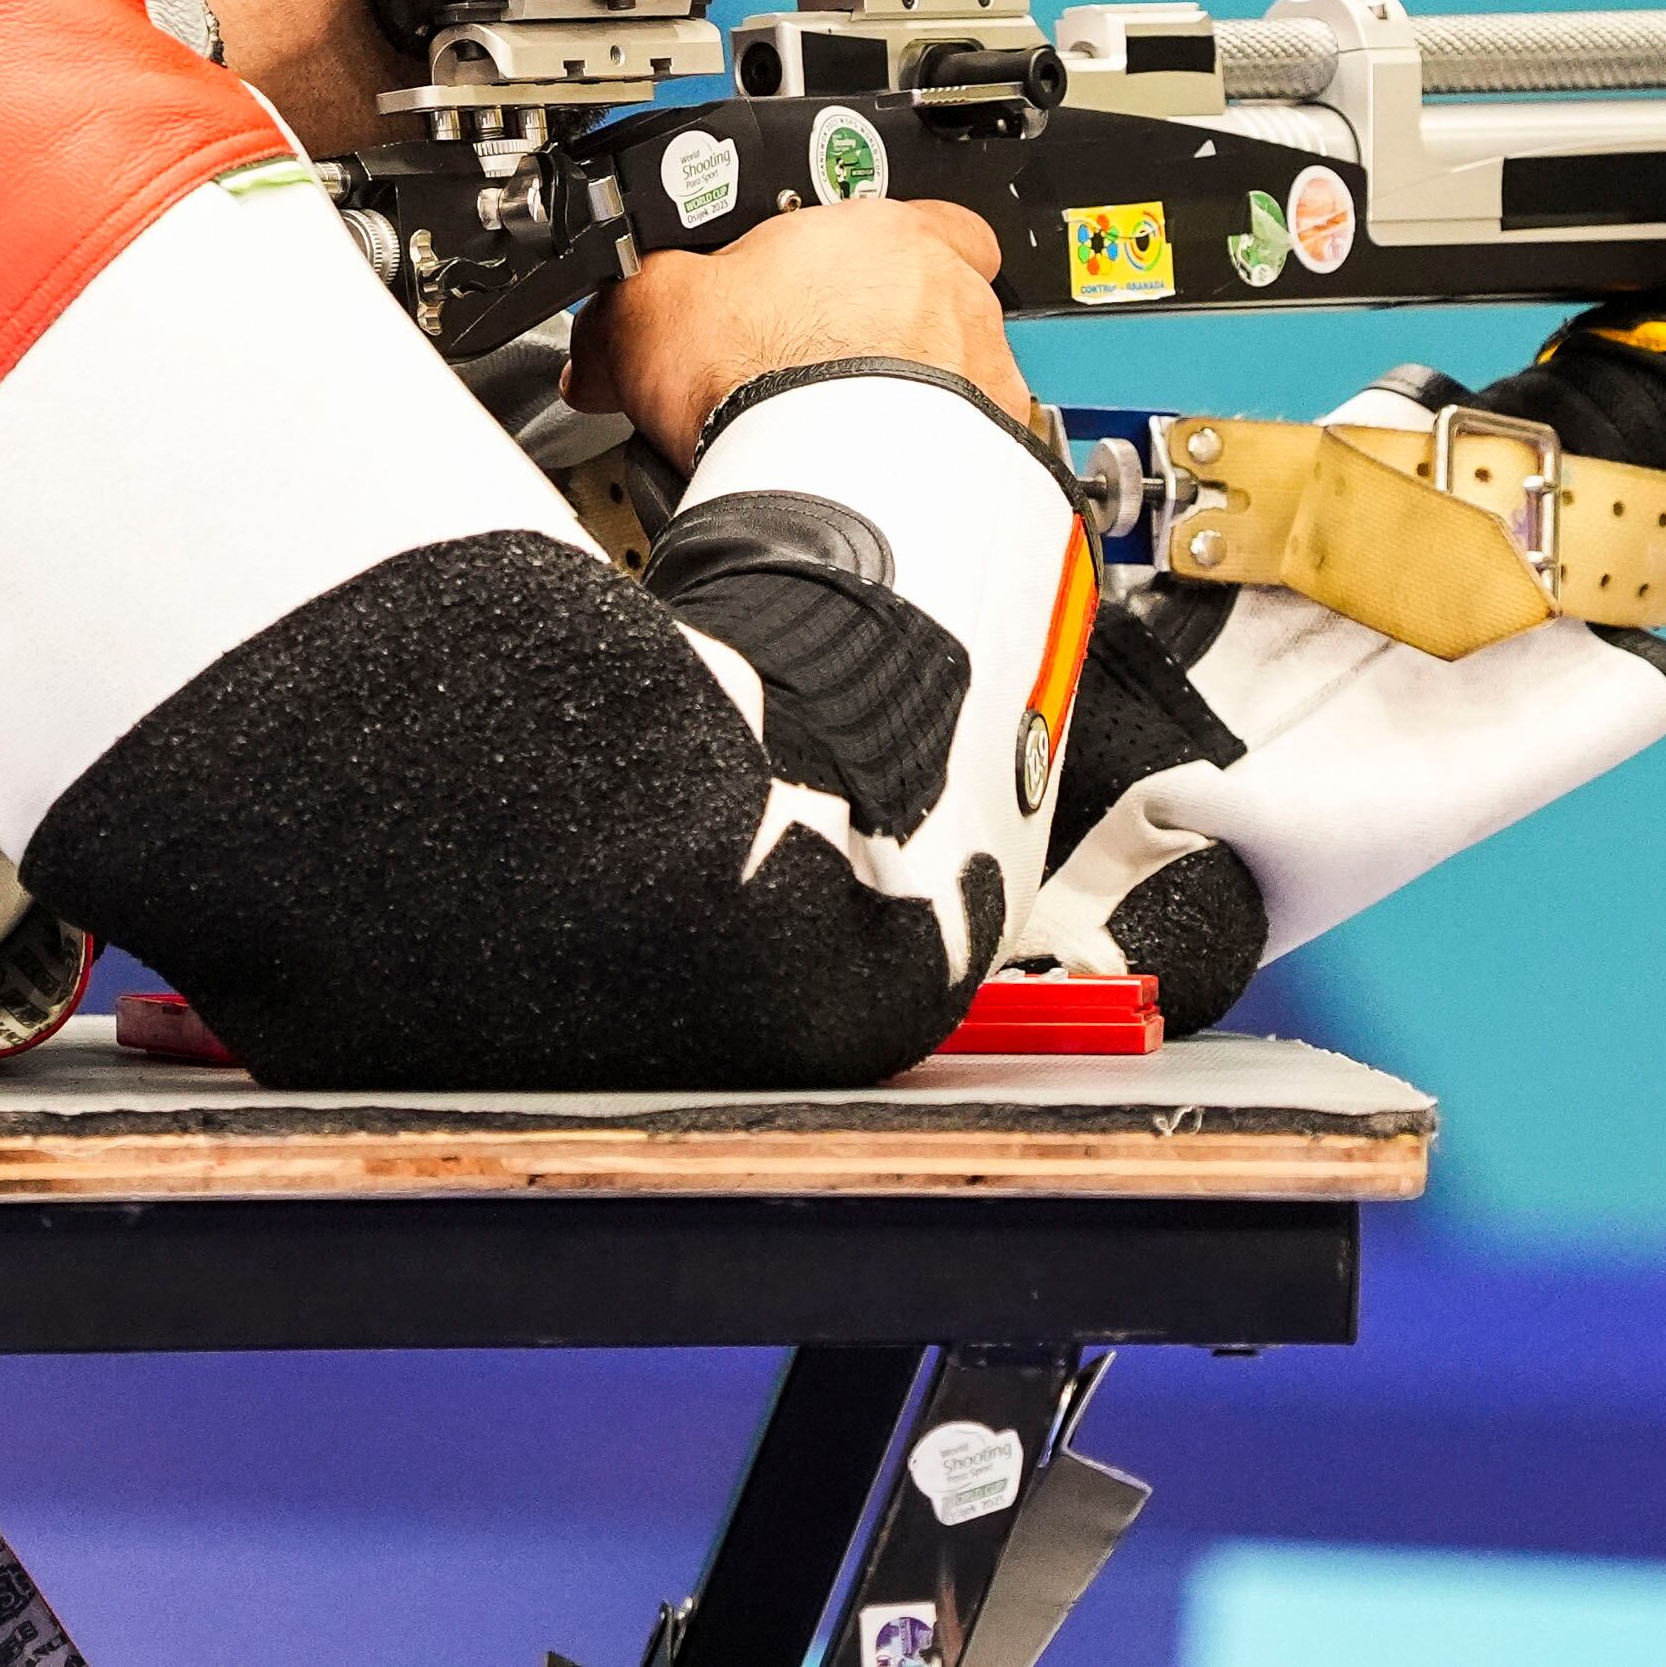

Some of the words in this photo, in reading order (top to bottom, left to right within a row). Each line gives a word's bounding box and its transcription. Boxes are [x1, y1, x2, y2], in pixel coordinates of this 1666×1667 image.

[680, 149, 700, 164] World
[682, 149, 731, 180] Shooting
[686, 178, 701, 190] Para
[701, 169, 719, 184] Sport
[685, 193, 712, 211] WORLD
[712, 186, 728, 200] CUP
[710, 199, 729, 214] 2023
[942, 1443, 1013, 1476] Shooting
